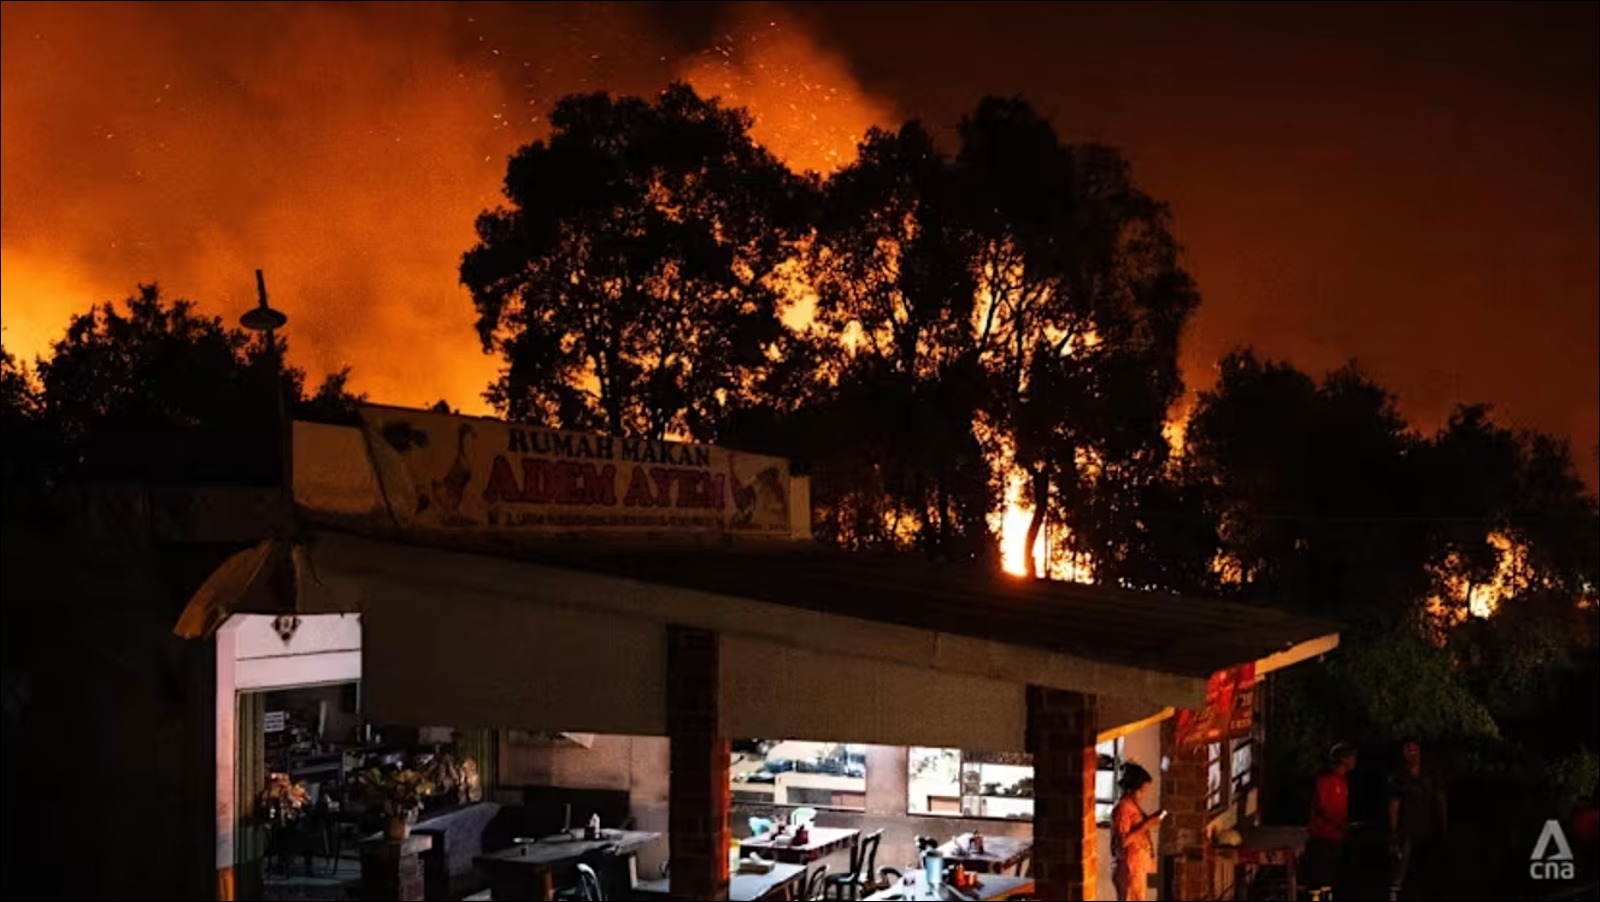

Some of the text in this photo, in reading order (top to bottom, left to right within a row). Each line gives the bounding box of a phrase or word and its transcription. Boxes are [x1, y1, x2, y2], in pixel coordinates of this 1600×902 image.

[507, 427, 711, 467] RUMAH MAKAN
[483, 455, 618, 506] ADEM
